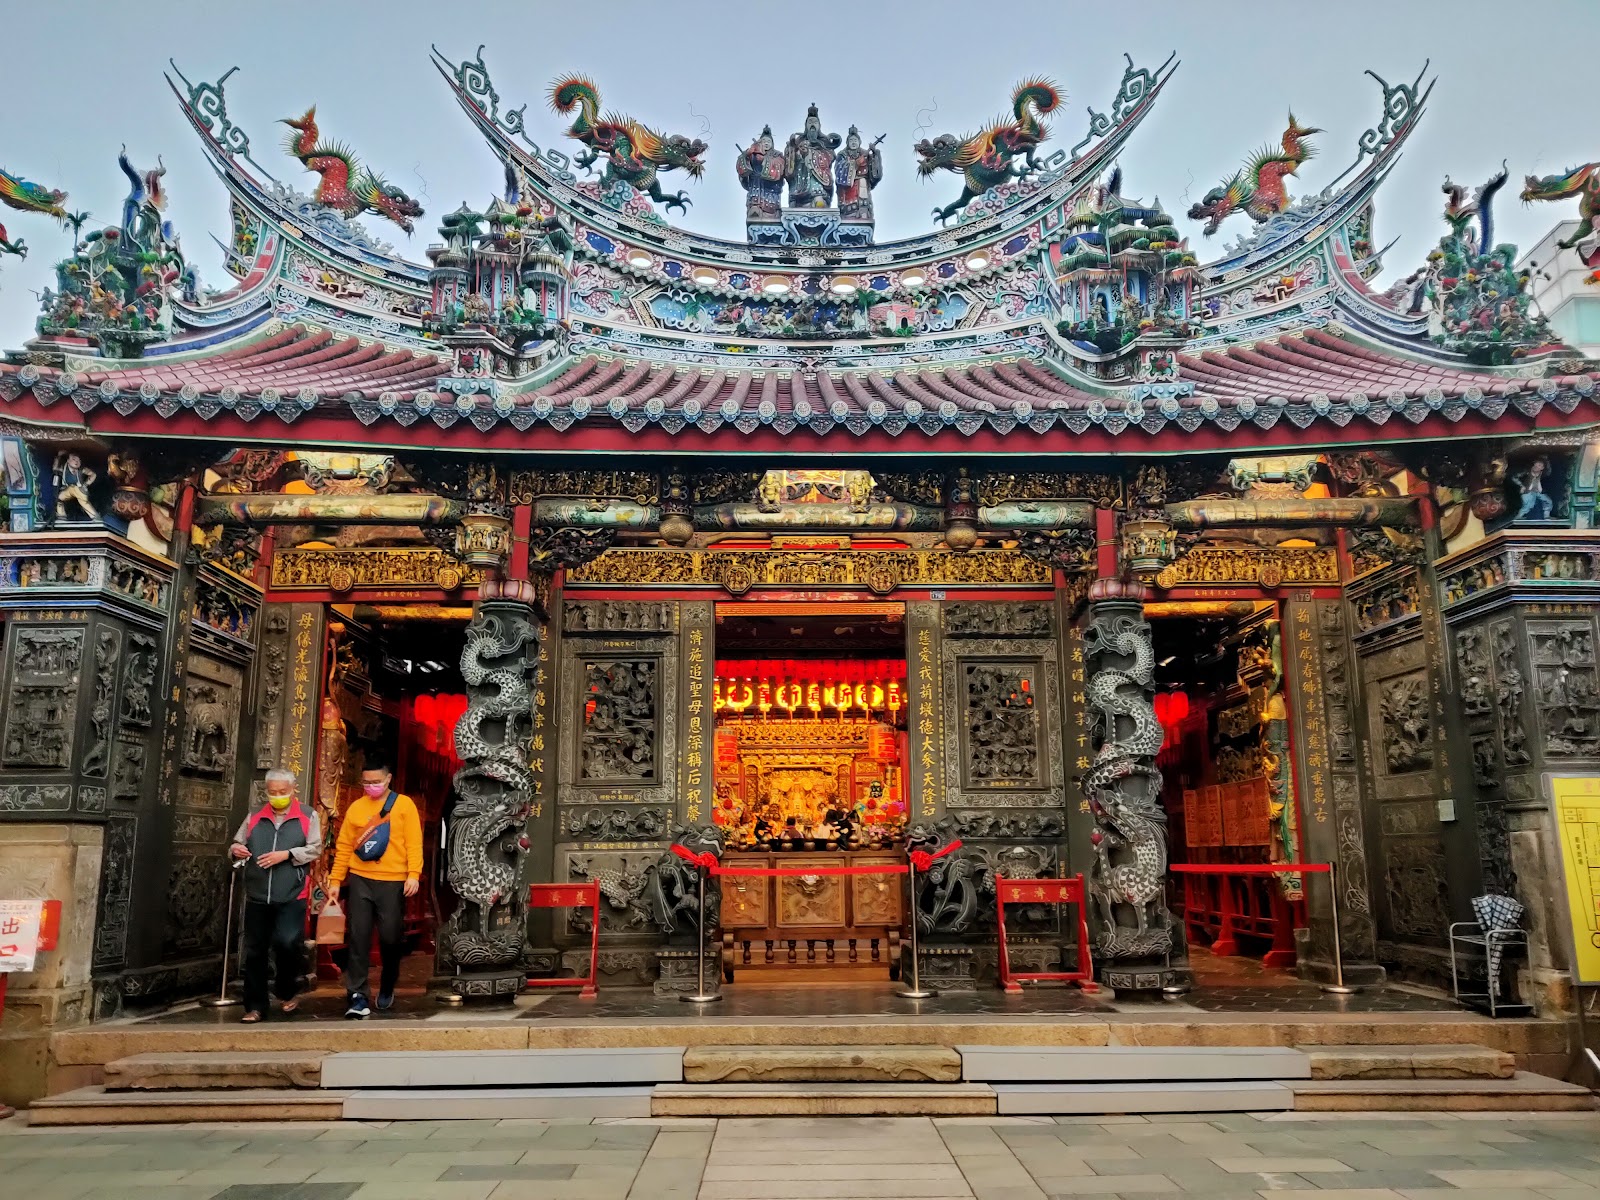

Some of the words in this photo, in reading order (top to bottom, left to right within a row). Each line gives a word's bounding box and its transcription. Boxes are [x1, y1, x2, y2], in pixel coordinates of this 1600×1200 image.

[1295, 593, 1310, 602] 179
[1070, 626, 1091, 814] 績著湄洲享千秋典
